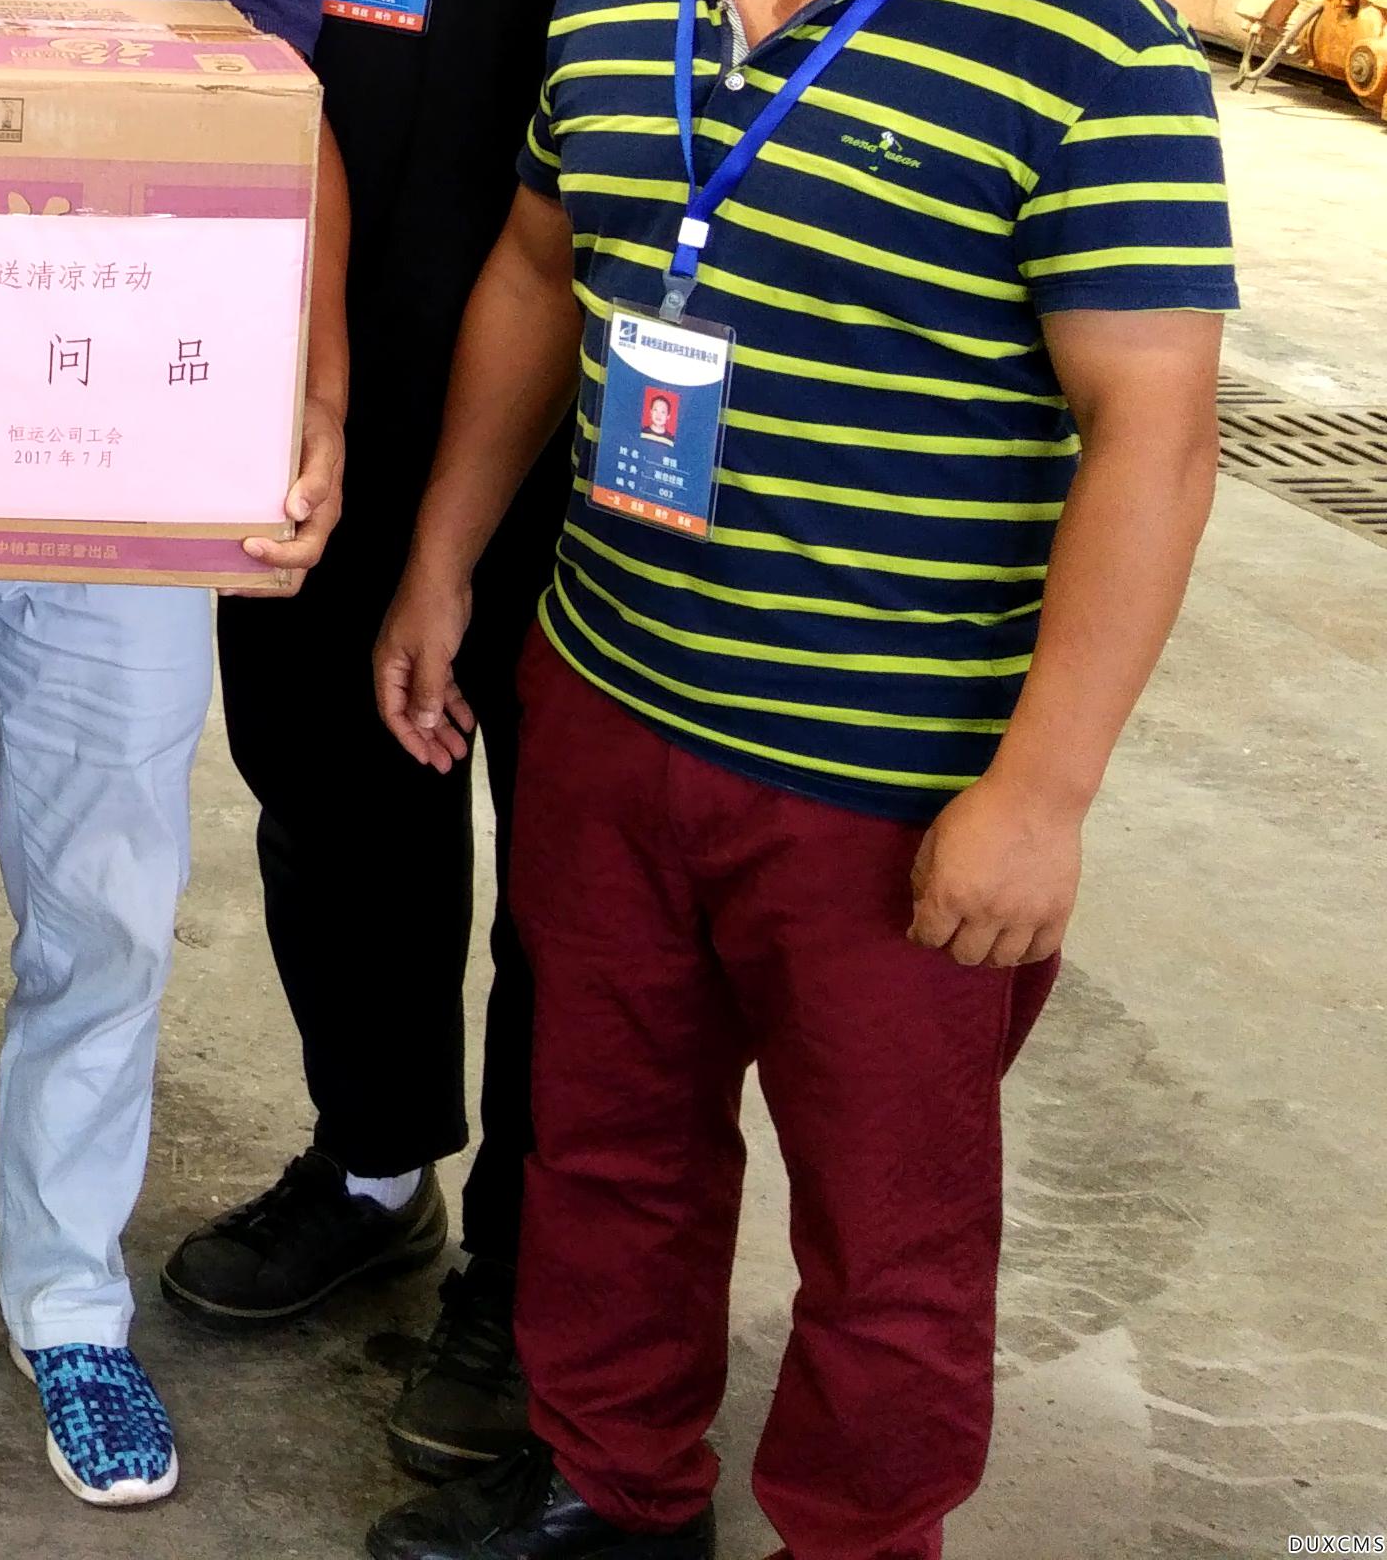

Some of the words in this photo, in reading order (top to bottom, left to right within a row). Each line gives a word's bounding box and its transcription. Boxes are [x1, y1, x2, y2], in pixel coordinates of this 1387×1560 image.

[7, 425, 123, 446] 恒运公司工会
